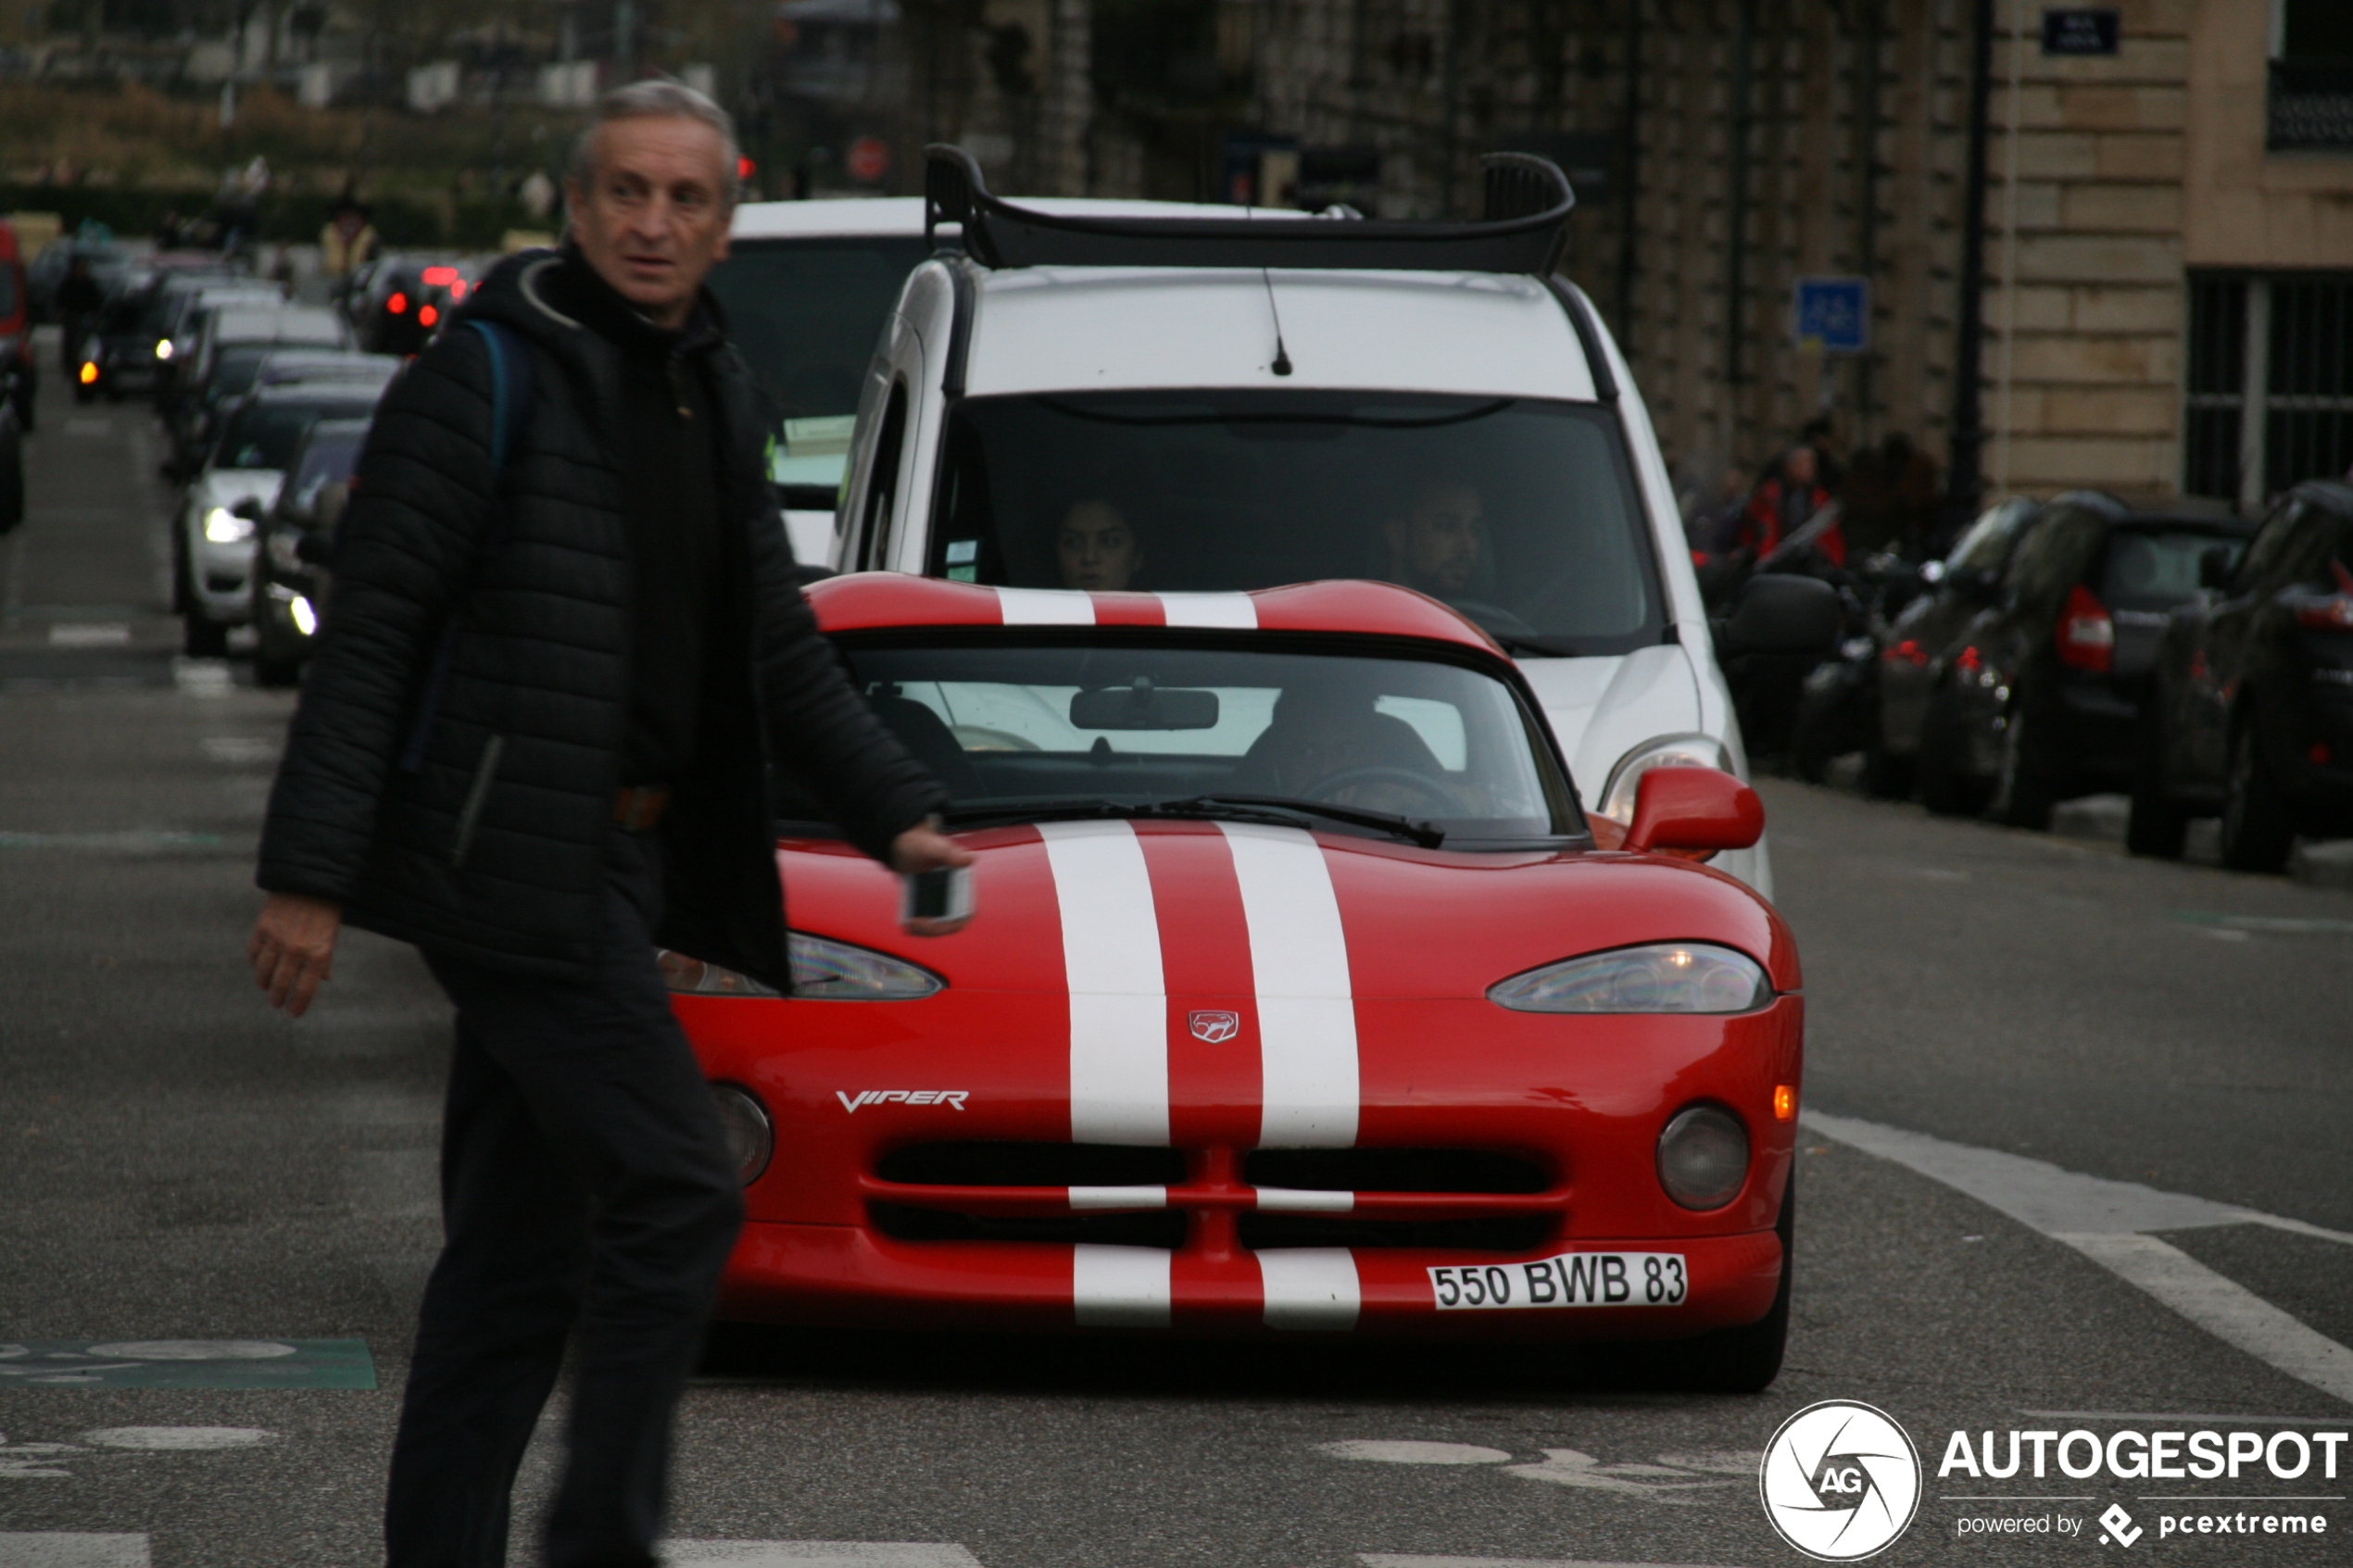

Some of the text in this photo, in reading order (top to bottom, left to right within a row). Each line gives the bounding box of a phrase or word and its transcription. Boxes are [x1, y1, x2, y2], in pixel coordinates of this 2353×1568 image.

[836, 1090, 970, 1113] VIPER
[1434, 1255, 1685, 1306] 550 BWB 83
